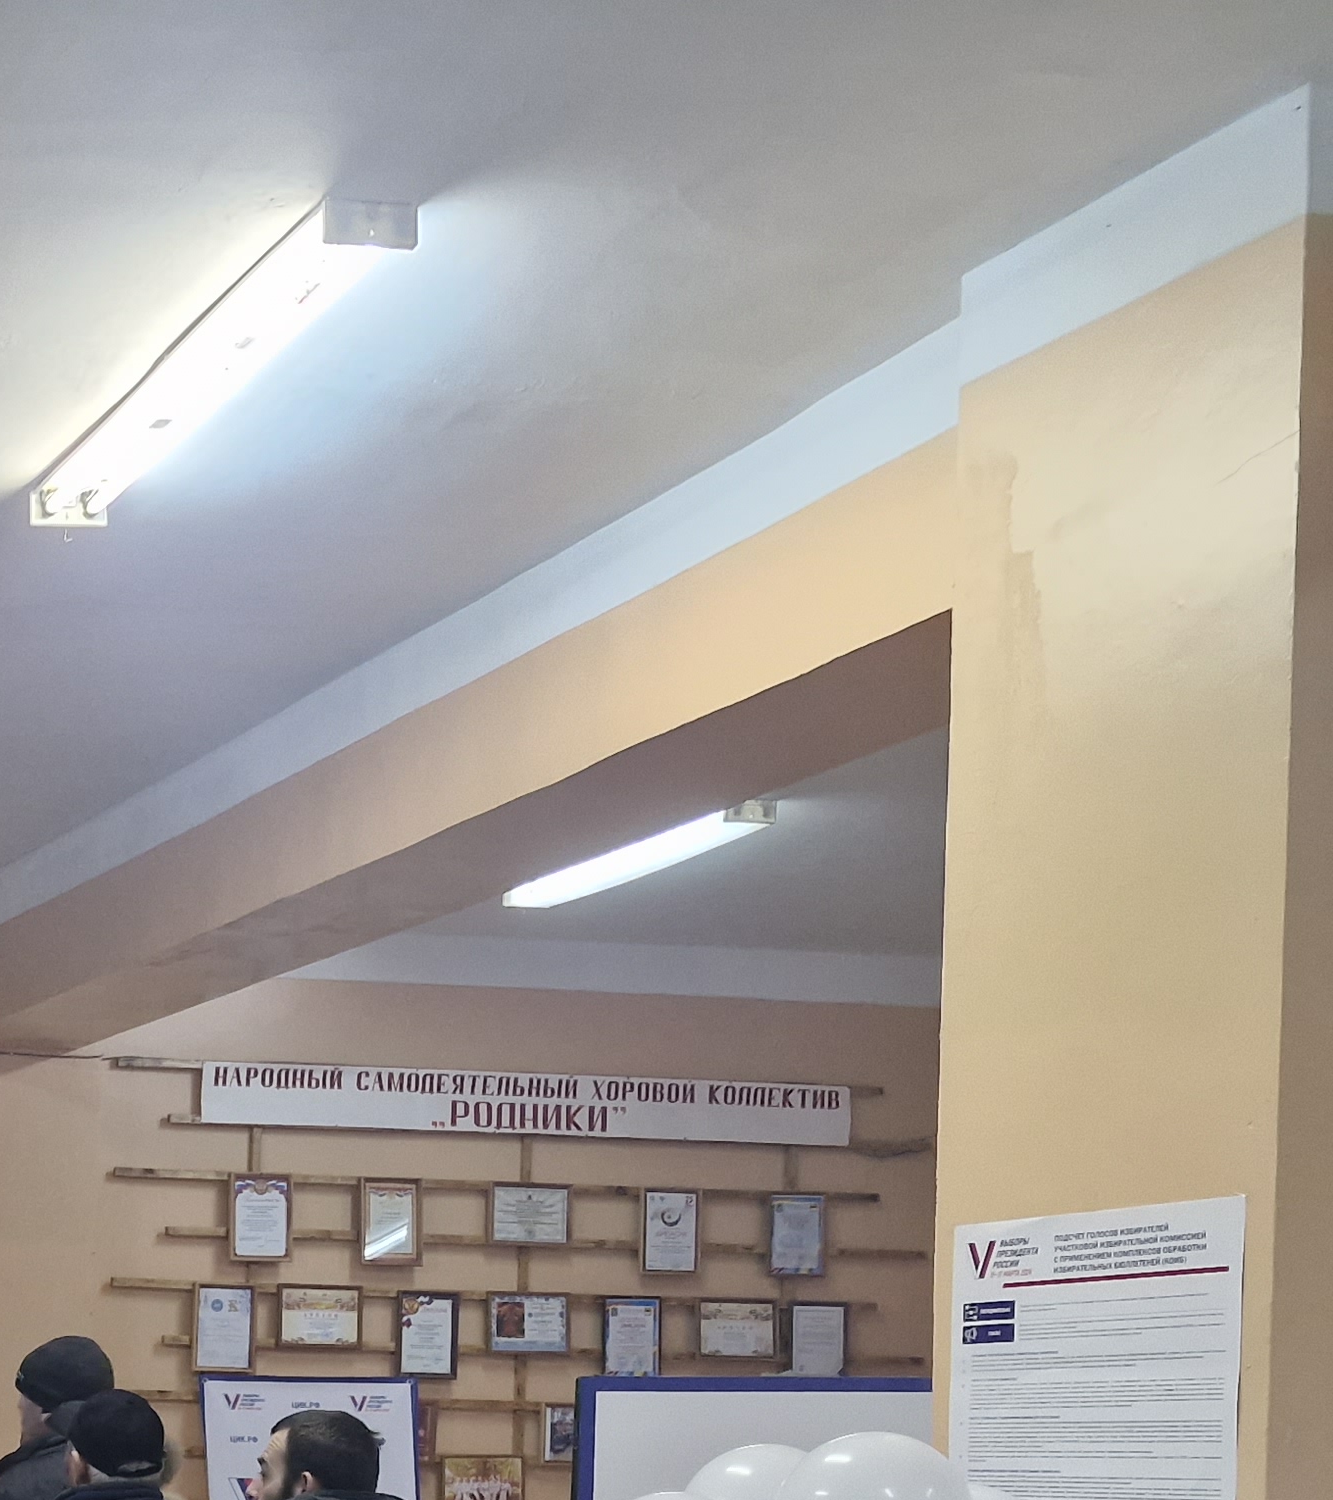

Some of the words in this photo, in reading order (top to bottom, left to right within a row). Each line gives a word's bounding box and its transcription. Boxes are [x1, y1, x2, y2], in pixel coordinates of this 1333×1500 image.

[213, 1066, 343, 1091] НАРОДНЫЙ
[356, 1070, 578, 1099] САМОДЕЯТЕЛЬНЫЙ
[591, 1079, 696, 1105] ХОРОВОЙ
[707, 1084, 841, 1110] КОЛЛЕКТИВ
